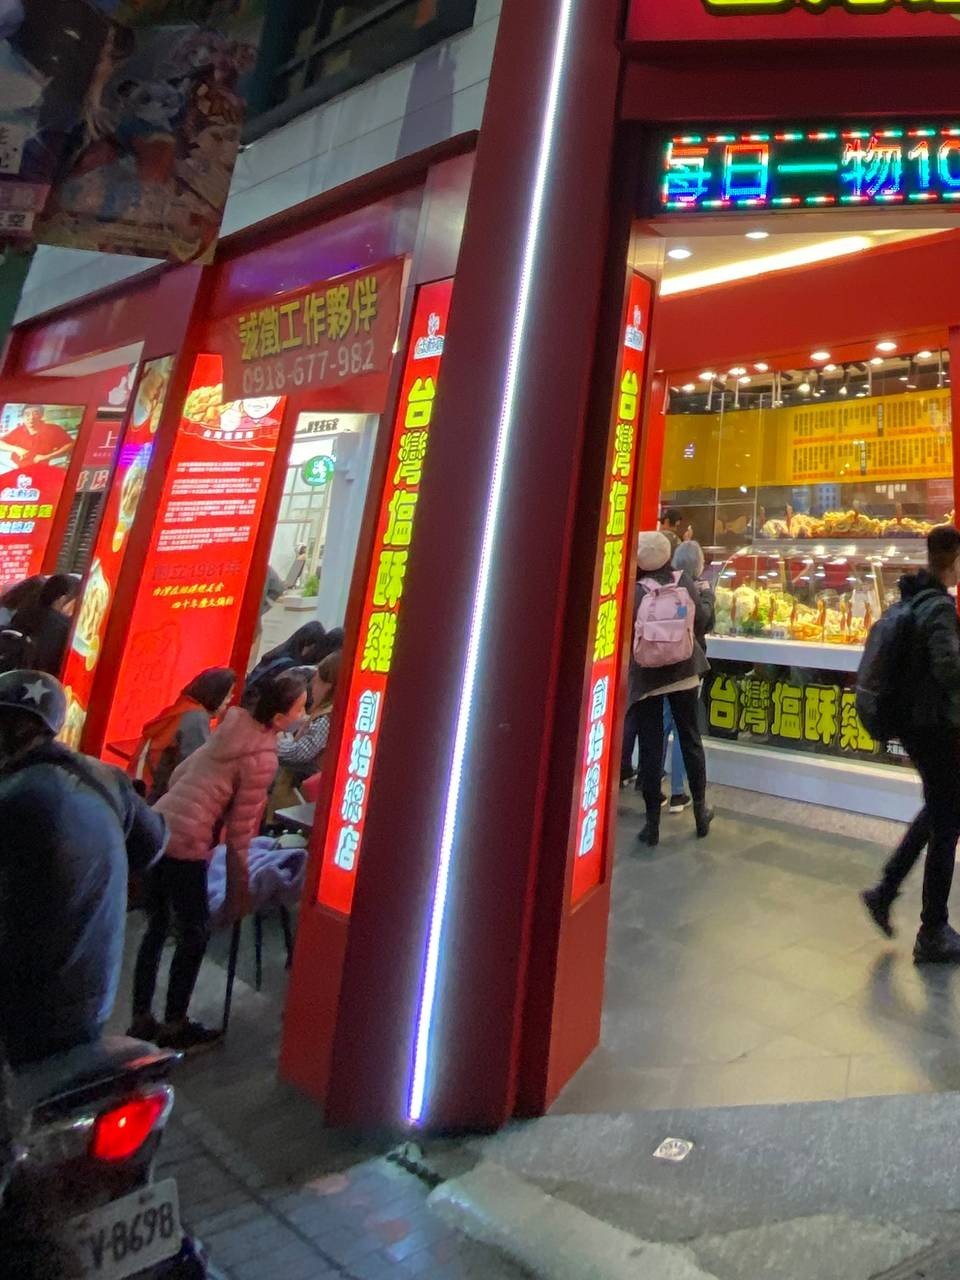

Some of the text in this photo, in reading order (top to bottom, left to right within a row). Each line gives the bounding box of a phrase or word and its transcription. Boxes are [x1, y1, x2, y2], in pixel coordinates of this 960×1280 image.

[238, 276, 379, 360] 誠徵工作夥伴
[361, 377, 435, 672] 台灣塩酥雞
[593, 370, 638, 662] 台灣塩酥雞
[334, 689, 381, 870] 創始總店
